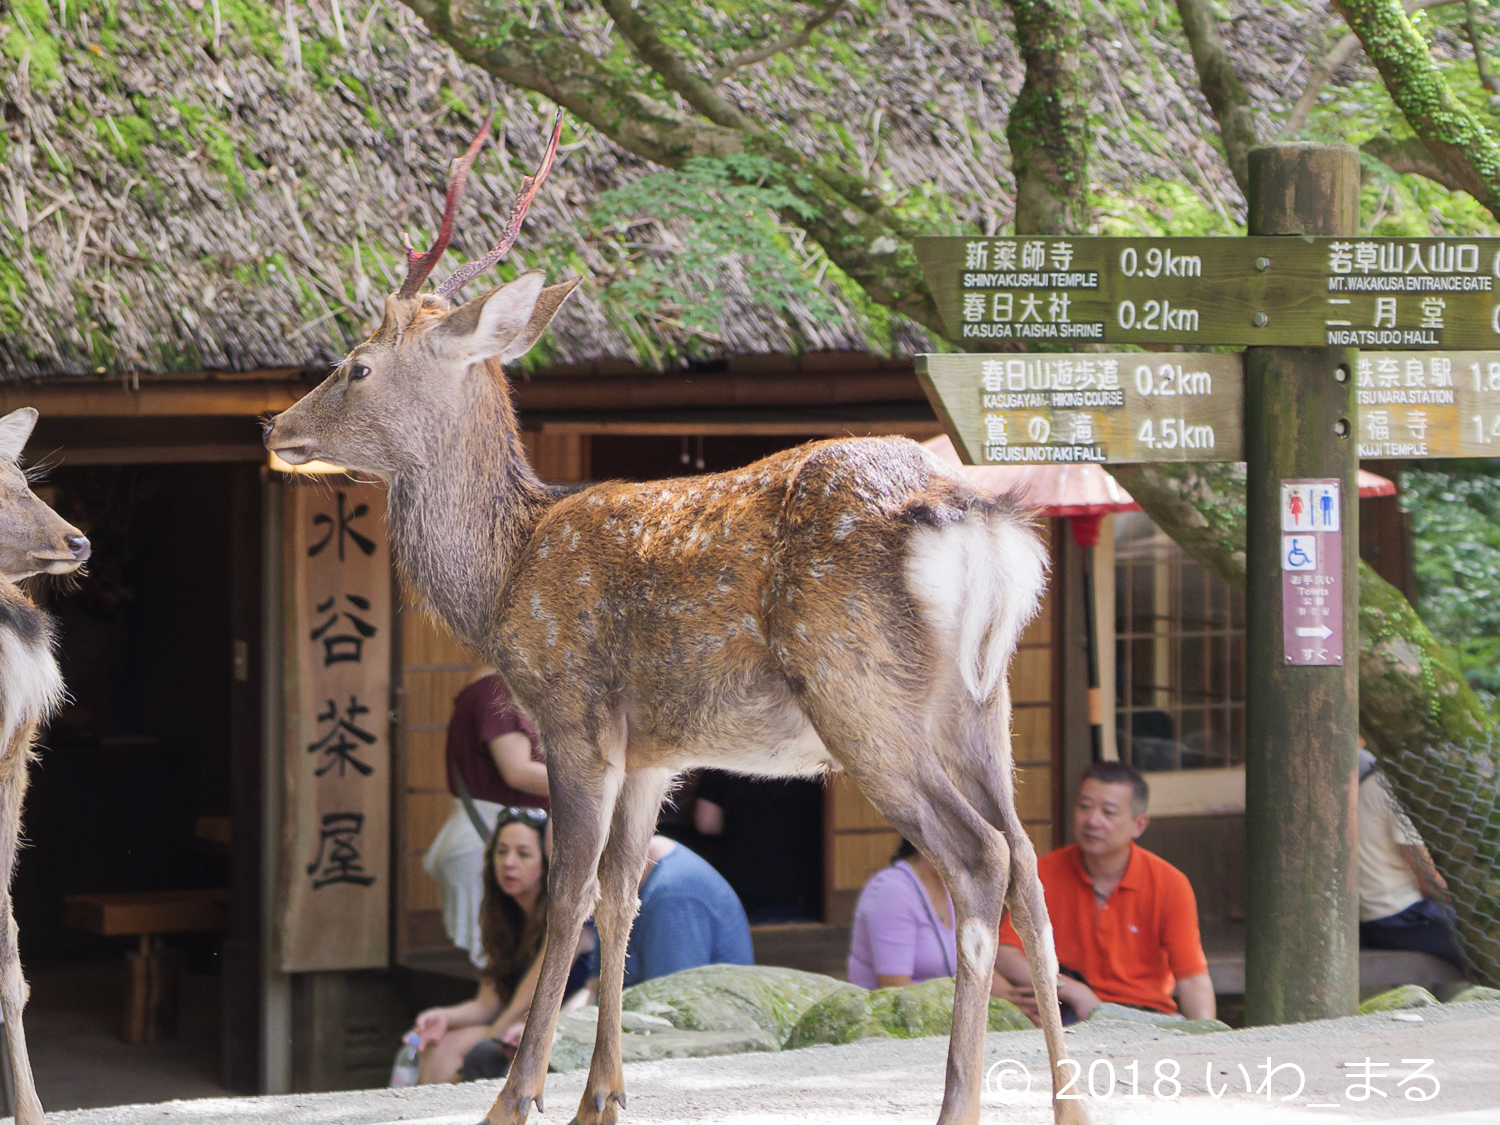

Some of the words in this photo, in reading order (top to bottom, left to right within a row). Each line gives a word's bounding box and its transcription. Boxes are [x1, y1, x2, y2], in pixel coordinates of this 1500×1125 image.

[966, 241, 1074, 271] 新薬師寺
[1121, 247, 1202, 277] 0.9km
[1328, 241, 1479, 274] 若草山入山口
[963, 273, 1049, 287] SHINYAKUSHIJI
[1050, 273, 1098, 287] TEMPLE
[1406, 276, 1463, 291] ENTRANCE
[1463, 276, 1492, 291] GATE
[963, 292, 1072, 323] 春日大社
[1118, 300, 1199, 331] 0.2km
[963, 324, 1012, 338] KASUGA
[1015, 324, 1058, 338] TAISHA
[1060, 324, 1103, 338] SHRINE
[1328, 330, 1401, 344] NIGATSUDO
[1404, 330, 1439, 344] HALL
[982, 359, 1120, 392] 春日山遊歩道
[1135, 364, 1212, 396] 0.2km
[1053, 391, 1084, 406] HIKING
[1085, 391, 1124, 406] COURSE
[1378, 390, 1408, 404] NARA
[1409, 390, 1454, 404] STATION
[1138, 418, 1215, 449] 4.5km
[985, 446, 1073, 462] UGUISUNOTAKI
[1074, 446, 1106, 461] FALL
[1386, 442, 1429, 456] TEMPLE
[1298, 586, 1330, 596] Toilets
[1301, 648, 1329, 661] すぐ
[307, 491, 377, 891] 水谷茶屋
